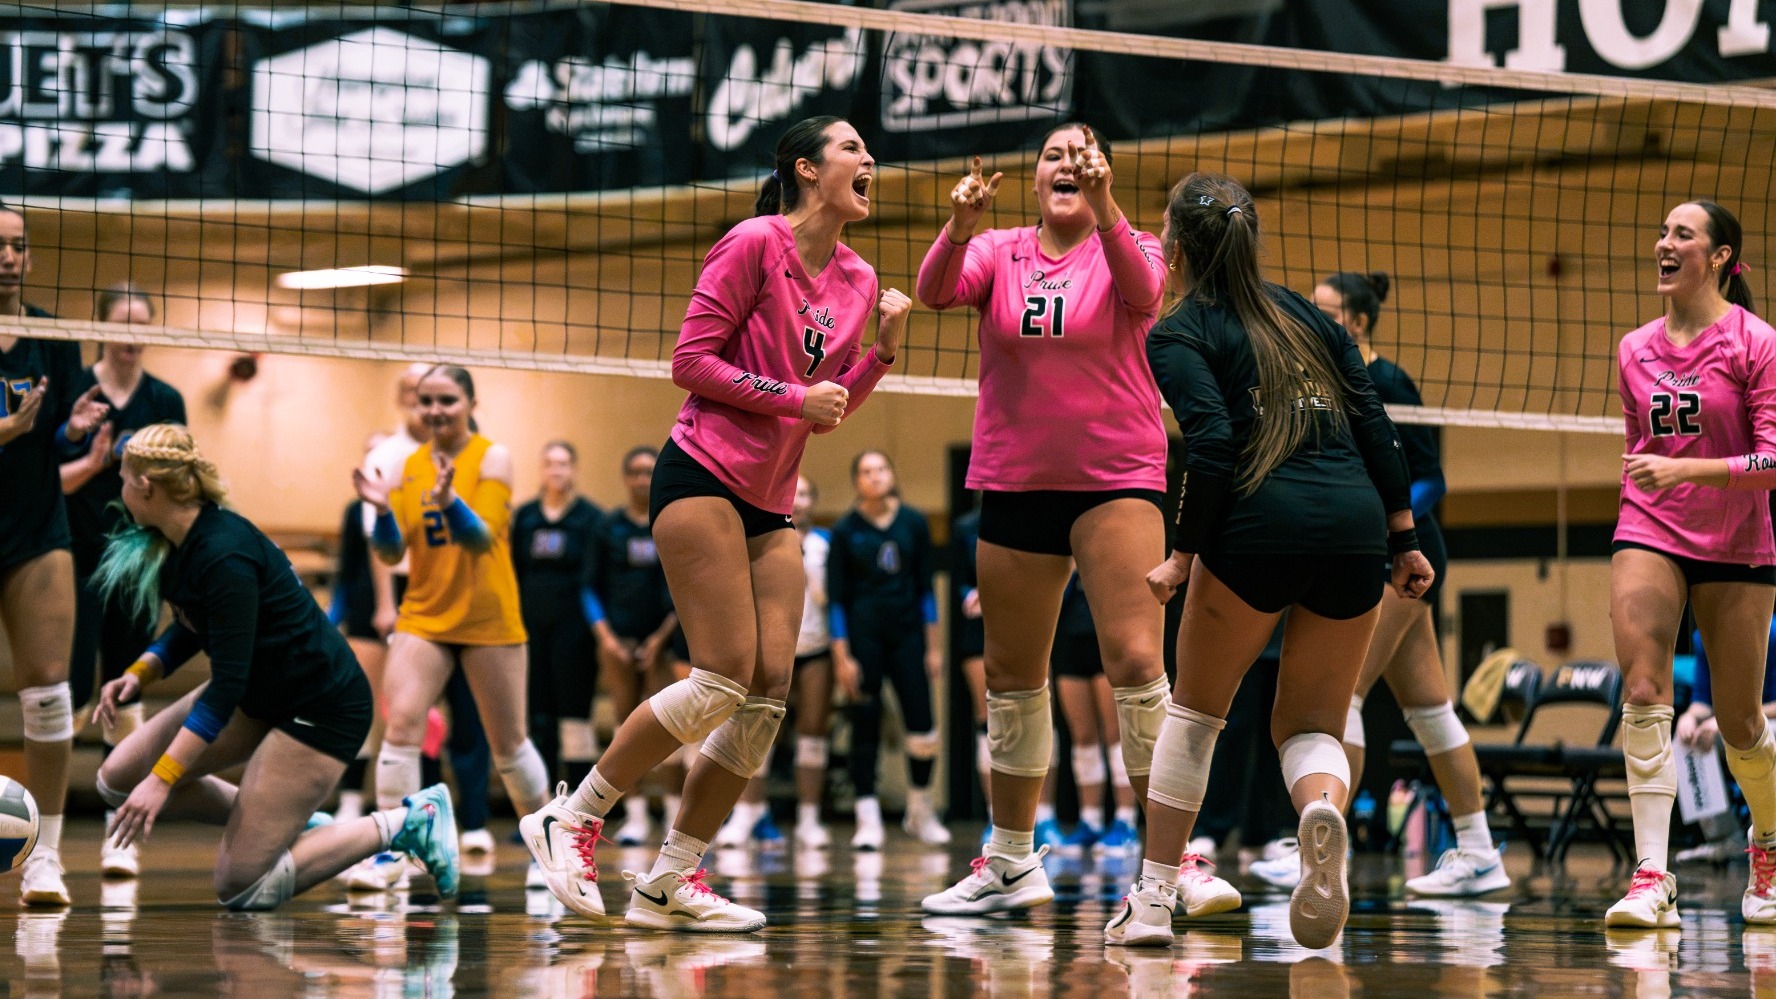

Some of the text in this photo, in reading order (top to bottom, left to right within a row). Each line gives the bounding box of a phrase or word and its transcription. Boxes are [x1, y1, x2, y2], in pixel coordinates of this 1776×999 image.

[889, 40, 1066, 115] SPORTS
[1020, 294, 1065, 337] 21
[801, 325, 827, 379] 4
[1653, 368, 1701, 388] Pride
[1649, 390, 1702, 438] 22
[1556, 665, 1608, 690] PNW
